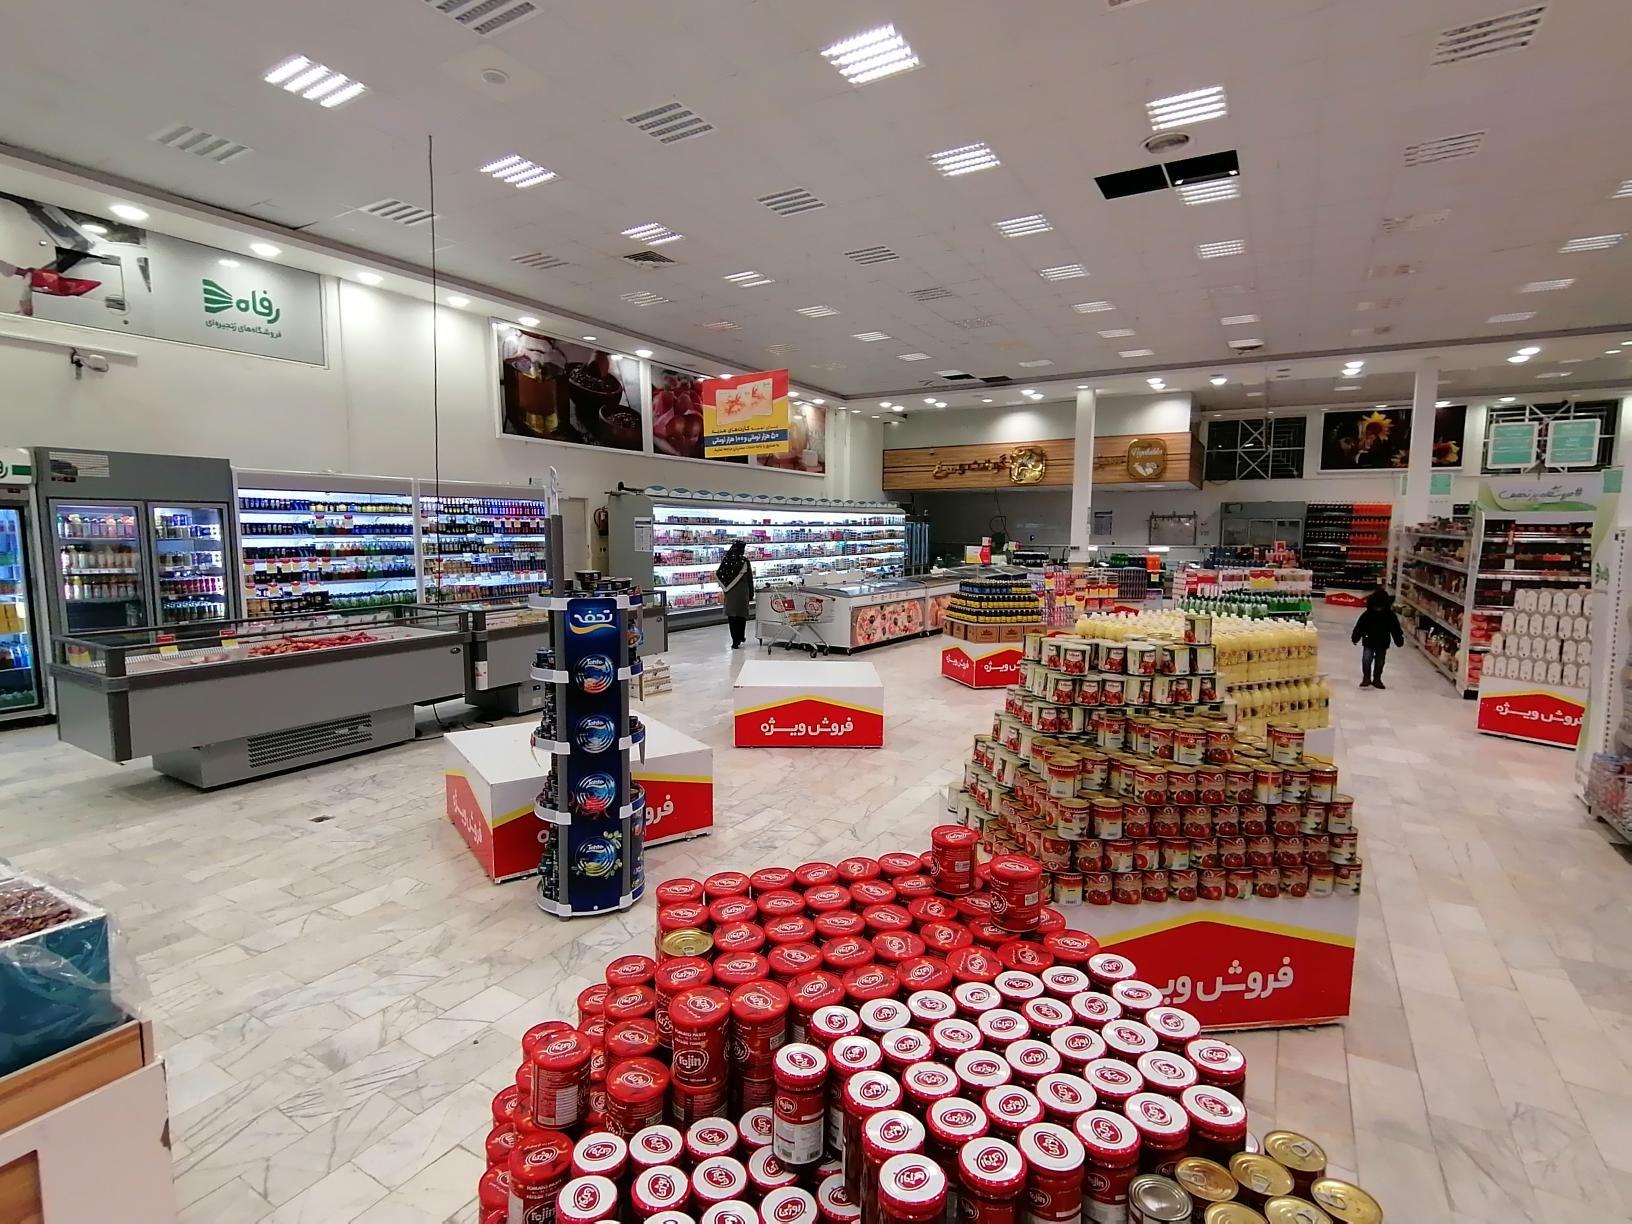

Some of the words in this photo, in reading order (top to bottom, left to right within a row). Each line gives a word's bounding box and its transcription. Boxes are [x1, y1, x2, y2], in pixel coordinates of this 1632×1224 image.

[236, 290, 280, 324] رفاه
[984, 660, 1008, 672] ویژه
[1496, 702, 1539, 720] ویژه
[760, 716, 806, 736] ویژه
[808, 716, 853, 736] فروش
[646, 794, 674, 825] فرو
[1196, 956, 1294, 1001] فروش
